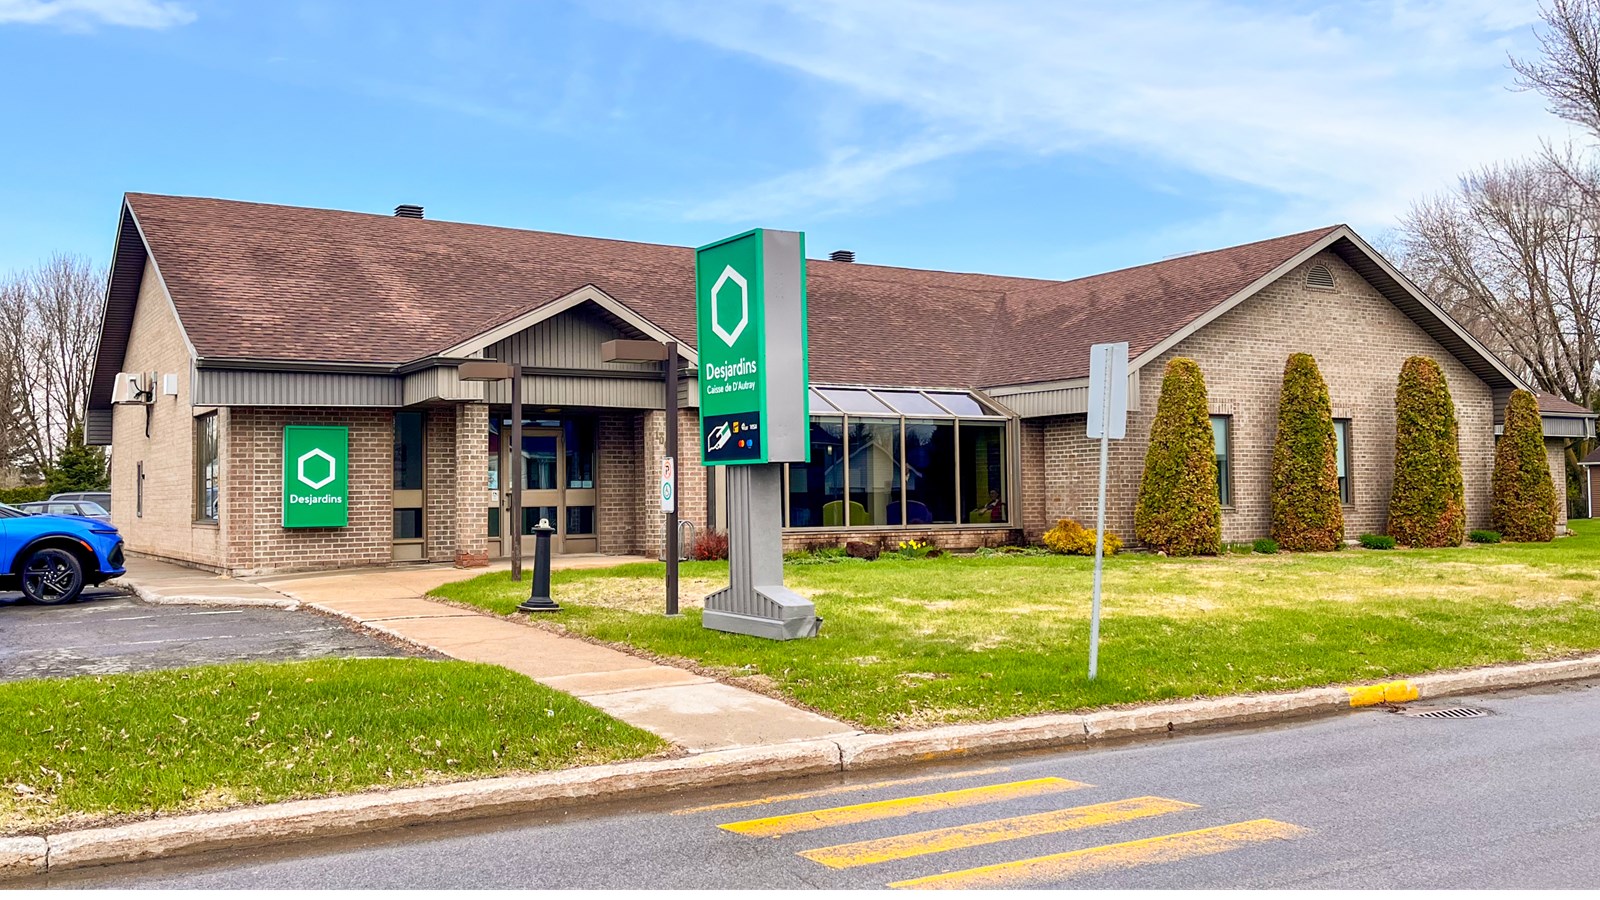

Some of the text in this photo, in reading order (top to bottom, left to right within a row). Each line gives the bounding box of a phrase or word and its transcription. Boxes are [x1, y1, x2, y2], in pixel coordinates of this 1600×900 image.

[706, 357, 757, 382] Desjardins
[706, 380, 756, 394] Caisse de D'Autray
[290, 494, 342, 506] Desjardins
